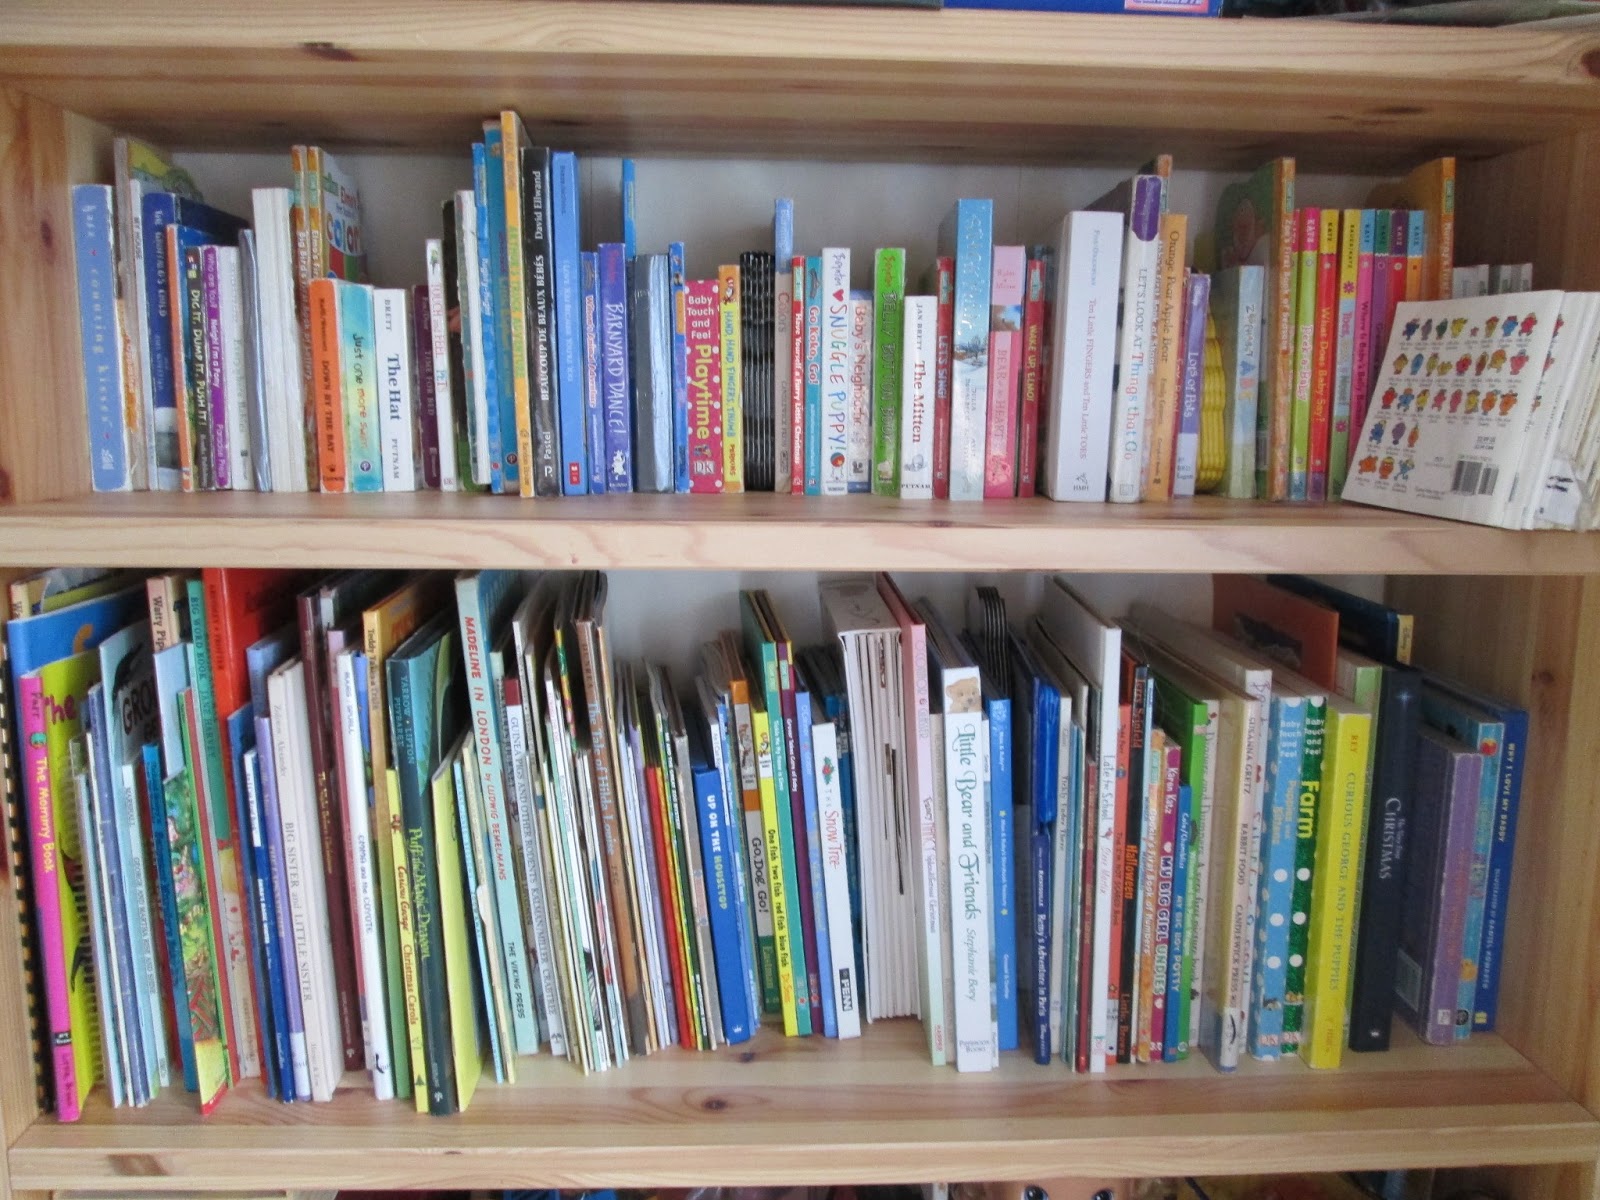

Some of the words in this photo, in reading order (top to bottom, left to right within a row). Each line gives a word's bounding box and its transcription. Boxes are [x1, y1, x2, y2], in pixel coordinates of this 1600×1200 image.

[1166, 231, 1180, 271] Orange
[1138, 269, 1147, 298] LET'S
[1166, 276, 1176, 299] Pear
[384, 299, 392, 331] BRETT
[688, 296, 712, 305] Baby
[778, 292, 789, 332] Colors
[691, 320, 710, 328] and
[1135, 301, 1147, 331] LOOK
[1162, 303, 1175, 333] Apple
[1320, 307, 1331, 338] What
[538, 328, 546, 342] DE
[606, 303, 625, 376] BARNYARD
[691, 331, 711, 339] Feel
[830, 305, 848, 383] SNUGGLE
[1134, 336, 1141, 349] AT
[1162, 337, 1172, 364] Bear
[1187, 352, 1199, 377] Lots
[1320, 342, 1328, 366] Does
[322, 360, 332, 391] DOWN
[387, 354, 401, 386] The
[539, 345, 549, 401] BEAUCOUP
[914, 361, 925, 389] The
[1125, 353, 1143, 401] Things
[1316, 370, 1327, 395] Baby
[324, 394, 332, 407] BY
[693, 344, 713, 440] Playtime
[1185, 381, 1197, 391] of
[325, 410, 334, 430] THE
[389, 390, 402, 421] Hat
[608, 383, 626, 434] DANCE!
[828, 391, 846, 450] PUPPY!
[913, 394, 924, 443] Mitten
[1185, 394, 1196, 418] Pots
[1127, 407, 1140, 436] that
[216, 424, 226, 457] Paradise
[327, 434, 335, 452] BAY
[1124, 441, 1137, 460] Go
[218, 460, 227, 478] Press
[391, 438, 400, 479] PUTNAM
[190, 597, 199, 615] BIG
[193, 619, 202, 649] WORD
[465, 617, 481, 679] MADELINE
[197, 653, 205, 679] BOOK
[401, 676, 410, 715] YARROW
[474, 687, 484, 701] IN
[1135, 679, 1145, 704] Jerry
[201, 690, 209, 716] JANE
[205, 719, 215, 757] HARVEY
[588, 702, 599, 725] The
[1133, 708, 1143, 748] Seinfeld
[405, 728, 415, 764] LIPTON
[477, 711, 491, 765] LONDON
[511, 717, 522, 756] GUINEA
[593, 730, 604, 755] Tale
[953, 724, 976, 765] Little
[1246, 717, 1255, 760] SUSANNA
[1307, 738, 1322, 746] and
[1350, 735, 1359, 753] REY
[36, 758, 47, 782] The
[484, 773, 492, 781] by
[515, 759, 523, 779] PIGS
[595, 759, 606, 772] of
[1102, 755, 1114, 777] Late
[1167, 767, 1178, 792] Karen
[488, 785, 498, 819] LUDWIG
[518, 783, 527, 803] AND
[599, 776, 609, 811] Hilda
[708, 795, 715, 809] UP
[956, 771, 976, 817] Bear
[1101, 793, 1111, 821] School
[1164, 794, 1177, 814] Katz
[1343, 773, 1356, 827] CURIOUS
[39, 788, 50, 839] Mommy
[521, 805, 530, 837] OTHER
[709, 813, 717, 828] ON
[1296, 781, 1319, 838] Farm
[284, 822, 294, 843] BIG
[408, 827, 423, 857] Puff
[603, 816, 614, 855] Louise
[712, 831, 720, 852] THE
[963, 823, 977, 848] and
[1240, 823, 1248, 855] RABBIT
[1379, 797, 1399, 879] CHRISTMAS
[42, 843, 53, 873] Book
[492, 823, 506, 880] BEMELMANS
[526, 840, 536, 883] RODENTS
[1339, 833, 1350, 881] GEORGE
[287, 847, 298, 888] SISTER
[1124, 845, 1138, 899] Halloween
[1163, 856, 1174, 878] MY
[1238, 858, 1246, 885] FOOD
[398, 866, 408, 899] Curious
[414, 874, 426, 909] Magic
[714, 856, 727, 909] HOUSETOP
[959, 853, 981, 920] Friends
[1159, 881, 1171, 905] BIG
[292, 893, 300, 909] and
[1336, 887, 1345, 912] AND
[294, 914, 307, 958] LITTLE
[414, 913, 431, 960] Dragon
[778, 916, 786, 930] fish
[1037, 914, 1046, 943] Remy's
[1156, 909, 1170, 941] GIRL
[1233, 905, 1243, 963] CANDLEWICK
[1334, 918, 1343, 940] THE
[403, 944, 414, 992] Christmas
[1038, 946, 1047, 984] Adventure
[1154, 944, 1168, 995] UNDIES
[1231, 968, 1239, 992] PRESS
[1330, 944, 1342, 991] PUPPIES
[300, 963, 312, 1001] SISTER
[511, 961, 519, 989] VIKING
[515, 992, 525, 1018] PRESS
[1039, 986, 1046, 994] in
[408, 995, 418, 1025] Carols
